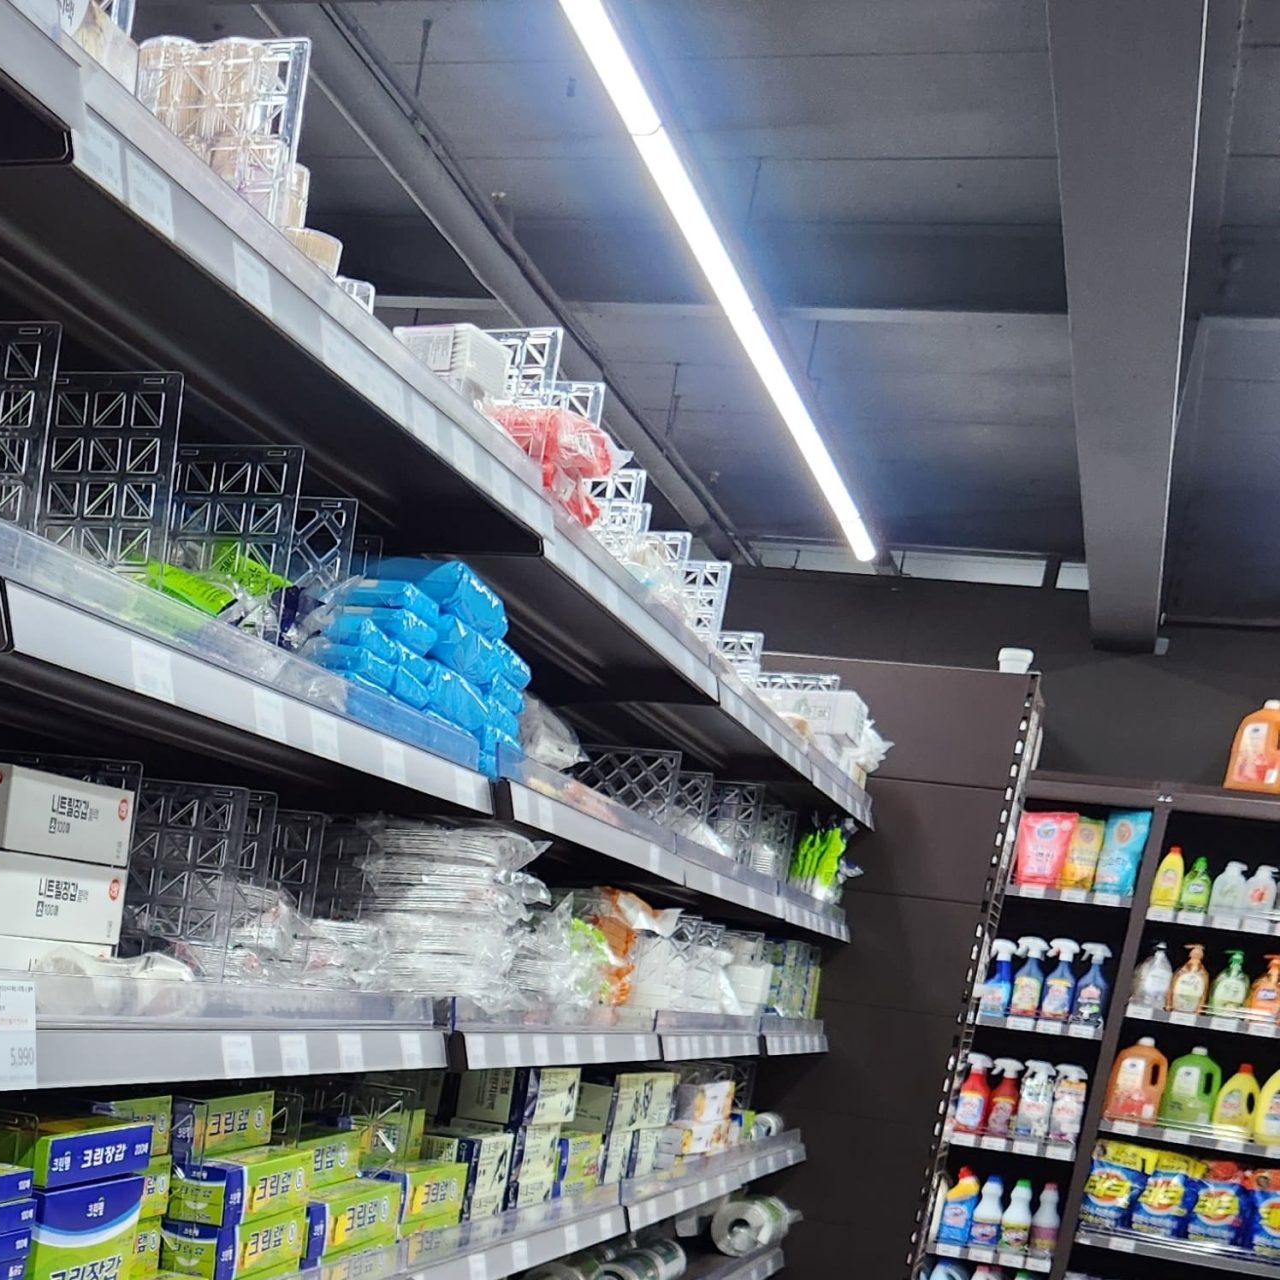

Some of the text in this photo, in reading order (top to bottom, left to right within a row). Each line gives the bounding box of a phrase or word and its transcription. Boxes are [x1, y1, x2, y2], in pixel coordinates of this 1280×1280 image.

[51, 794, 90, 820] 니트릴장갑
[38, 877, 78, 902] 니트릴장갑
[10, 1047, 35, 1067] 5,990
[81, 1143, 128, 1169] 크린장갑
